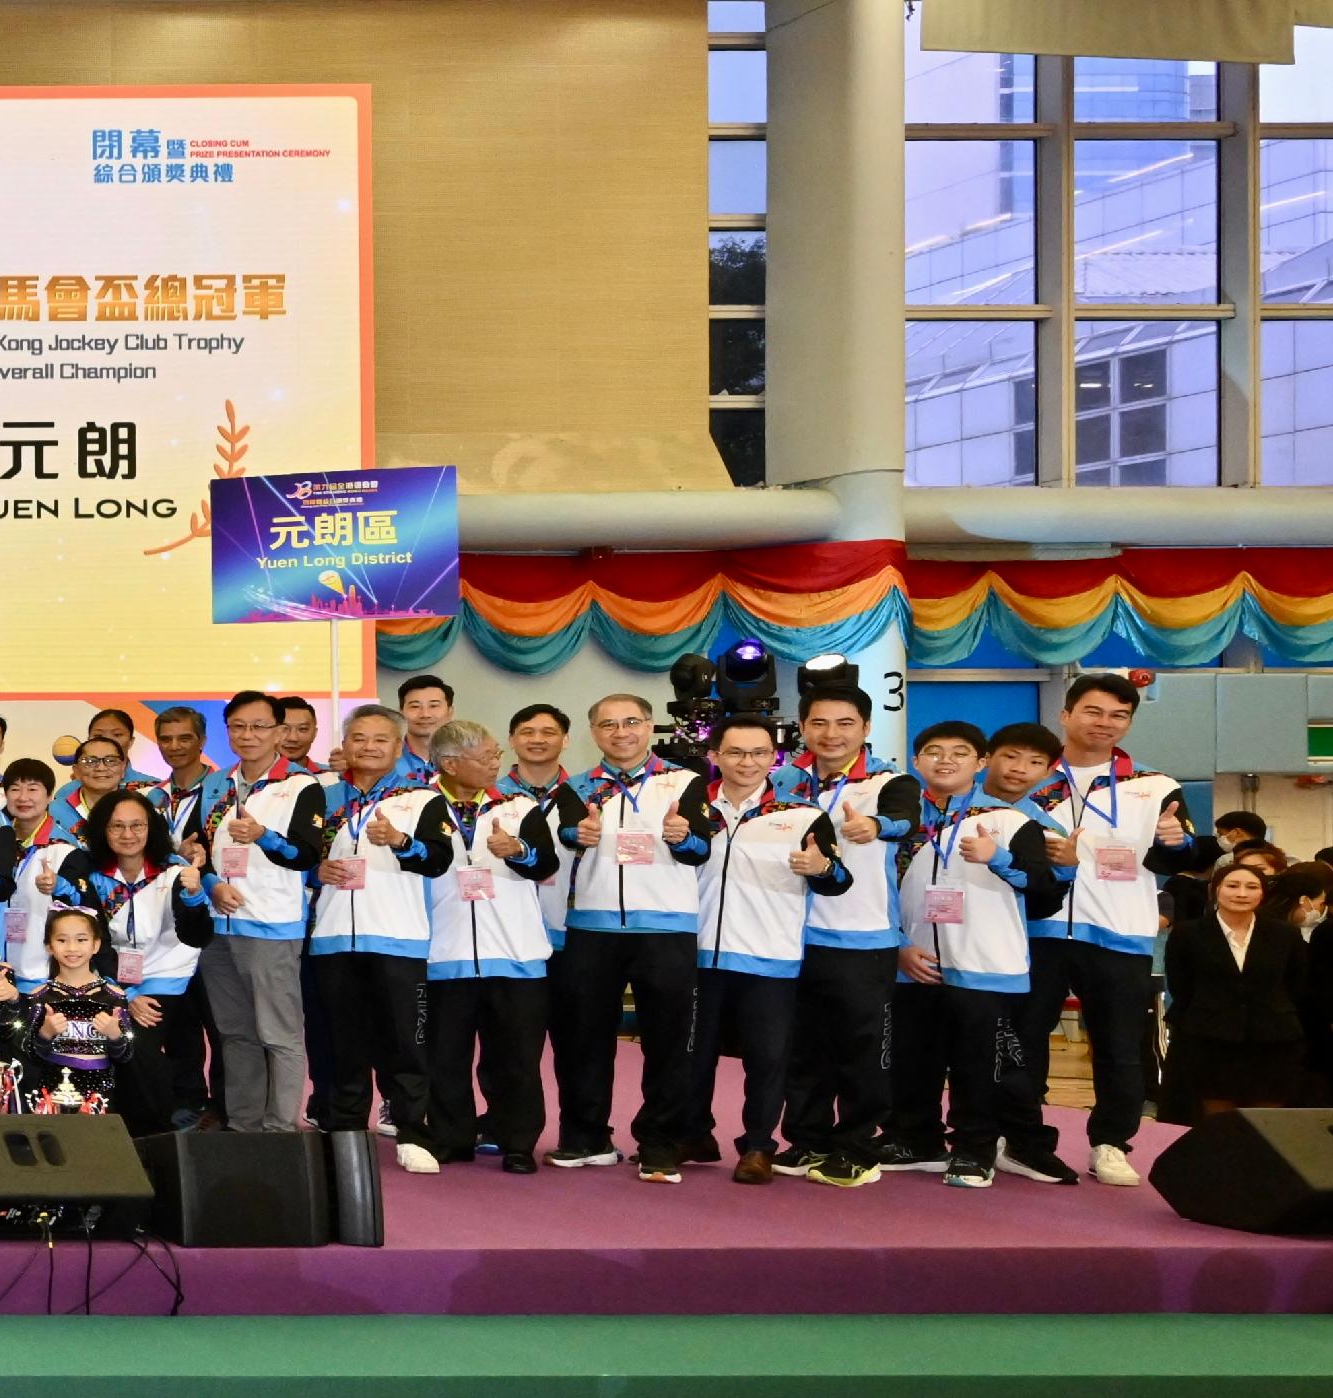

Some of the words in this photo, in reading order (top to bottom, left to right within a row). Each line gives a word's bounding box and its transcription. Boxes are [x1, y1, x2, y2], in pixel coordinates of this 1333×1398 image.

[92, 129, 187, 160] 閉幕暨
[190, 140, 227, 148] CLOSING
[217, 150, 280, 158] PRESENTATION
[94, 163, 234, 184] 綜合頒獎典禮
[48, 335, 117, 355] Jockey
[124, 333, 167, 351] Club
[173, 333, 245, 354] Trophy
[60, 363, 156, 384] Champion
[0, 421, 137, 480] 元朗
[74, 497, 177, 519] LONG
[269, 510, 398, 551] 元朗區
[256, 557, 298, 569] Yuen
[303, 555, 346, 570] Long
[351, 552, 413, 565] District
[883, 671, 905, 712] 3
